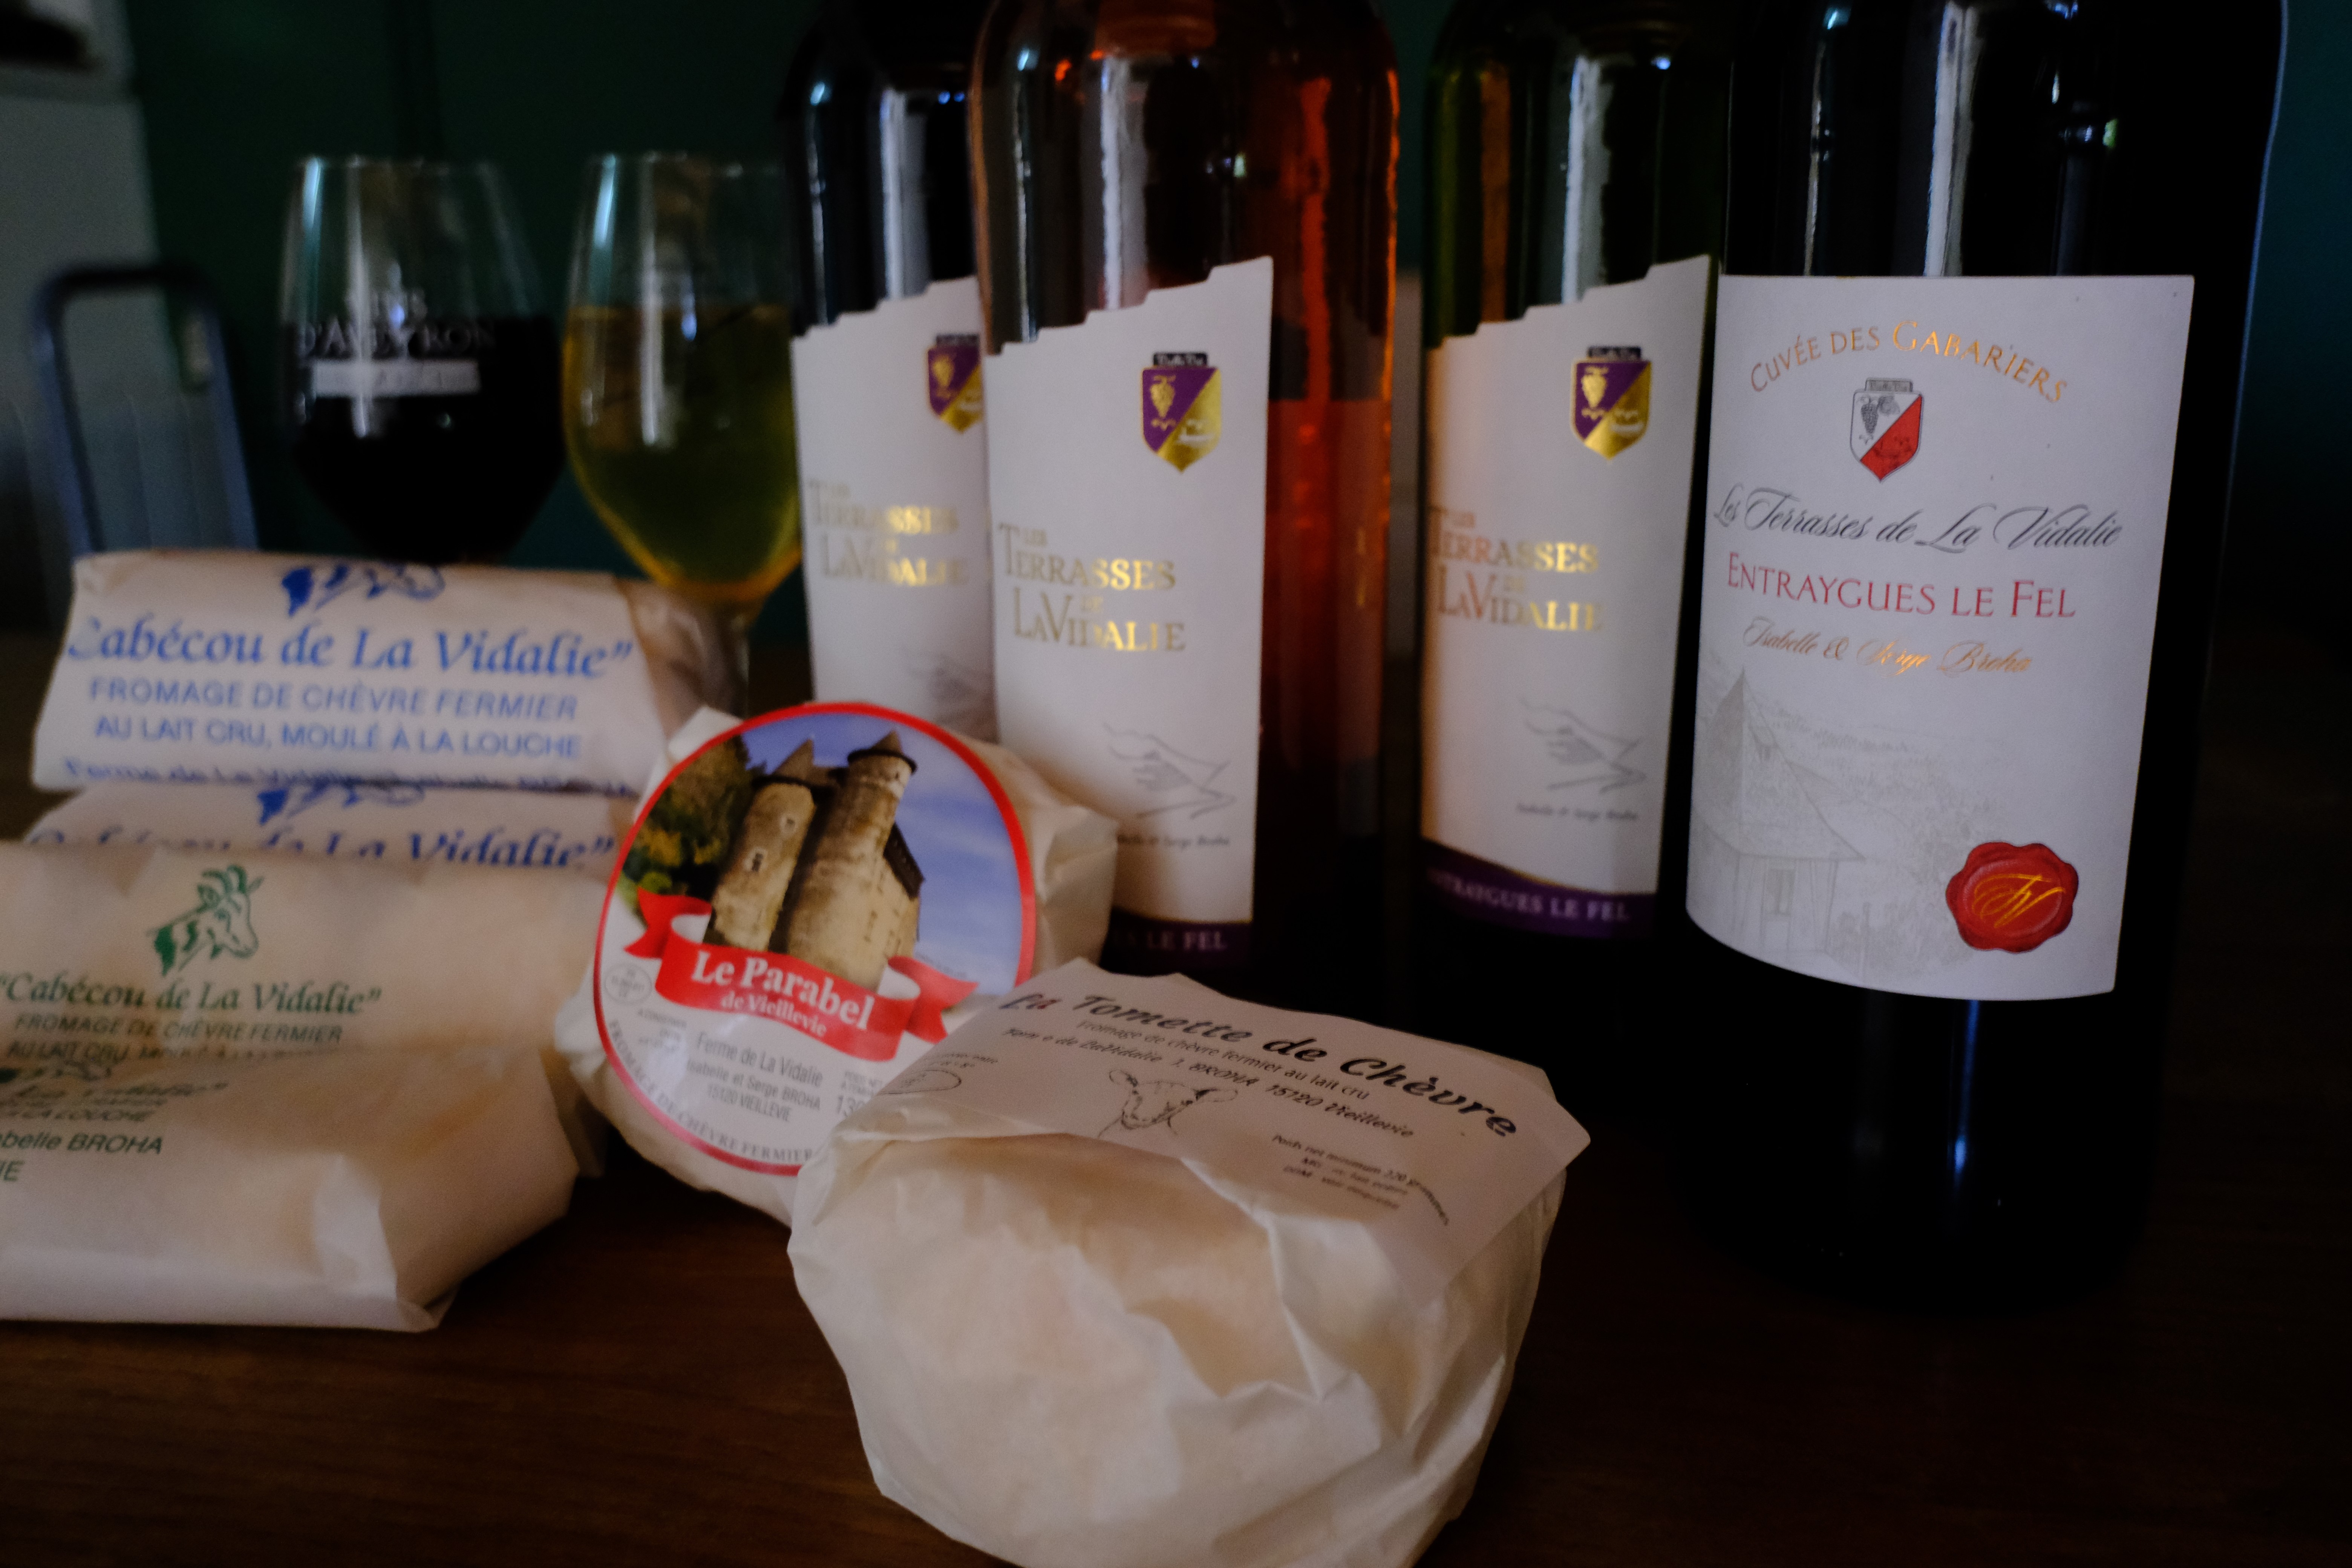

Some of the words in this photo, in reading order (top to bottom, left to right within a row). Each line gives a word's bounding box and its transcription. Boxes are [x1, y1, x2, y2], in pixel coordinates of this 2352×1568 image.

[1751, 335, 1821, 392] CUVÉE
[1830, 326, 1880, 354] DES
[1893, 321, 2067, 403] GABARIERS
[1713, 482, 1743, 527] Les
[1744, 487, 1873, 540] Terrasses
[1876, 509, 1922, 543] de
[1914, 503, 1997, 554] La
[1993, 504, 2122, 550] Vidalie
[1728, 551, 1936, 614] ENTRAYGUES
[1951, 587, 1994, 617] LE
[2011, 579, 2076, 618] FEL
[281, 621, 334, 666] de
[352, 627, 415, 669] La
[1743, 616, 1821, 655] Isabelle
[1823, 637, 1849, 660] &
[1937, 640, 2033, 677] Broha
[89, 677, 242, 707] FROMAGE
[253, 681, 292, 709] DE
[303, 678, 426, 715] CHÈVRE
[437, 691, 578, 721] FERMIER
[95, 716, 131, 740] AU
[143, 717, 195, 742] LAIT
[419, 729, 453, 752] LA
[463, 731, 581, 758] LOUCHE
[156, 978, 190, 1010] de
[199, 982, 239, 1010] La
[692, 951, 735, 986] Le
[740, 957, 874, 1030] Parabel
[721, 991, 744, 1009] de
[748, 993, 827, 1037] Vieillevie
[686, 1058, 729, 1081] Isabelle
[732, 1073, 744, 1086] et
[746, 1075, 779, 1098] Serge
[781, 1084, 821, 1110] BROHA
[698, 1032, 738, 1060] Ferme
[740, 1047, 757, 1066] de
[760, 1051, 776, 1072] La
[780, 1056, 823, 1087] Vidalie
[1073, 995, 1253, 1043] Tomette
[1263, 1038, 1328, 1061] de
[1340, 1058, 1517, 1136] Chèvre
[1076, 1020, 1142, 1039] Fromage
[1144, 1033, 1165, 1045] de
[1168, 1038, 1220, 1056] chèvre
[1222, 1050, 1283, 1073] fermier
[1284, 1067, 1306, 1081] au
[1310, 1074, 1339, 1091] lait
[1341, 1085, 1370, 1100] cru
[740, 1093, 792, 1121] VIEILLEVIE
[1189, 1062, 1260, 1086] BROHA
[1265, 1084, 1323, 1107] 15120
[1325, 1102, 1414, 1137] Vieillevie
[0, 1130, 62, 1151] belle
[67, 1132, 162, 1154] BROHA
